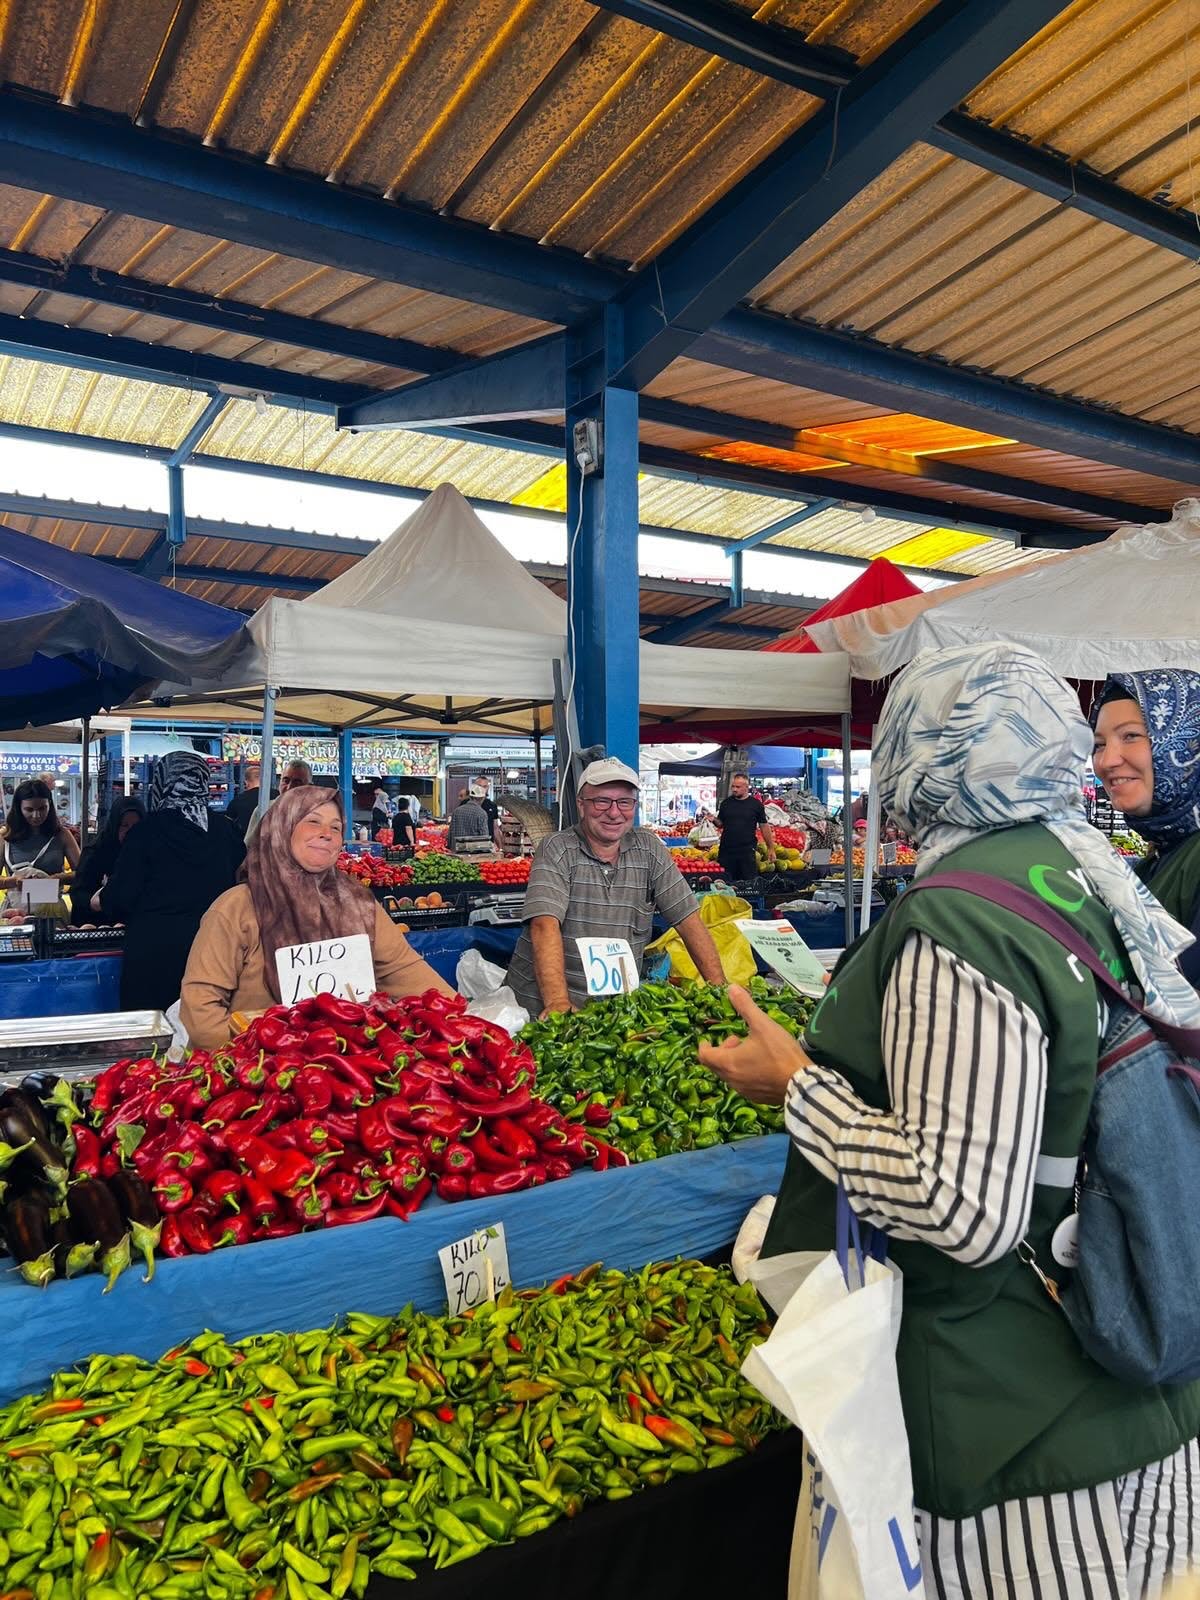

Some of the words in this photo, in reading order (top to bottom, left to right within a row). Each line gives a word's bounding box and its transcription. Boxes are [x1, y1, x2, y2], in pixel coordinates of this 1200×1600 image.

[22, 756, 56, 764] HAYATİ
[241, 741, 304, 757] YÖESEL
[308, 741, 371, 759] ÜRÜER
[376, 747, 423, 760] PAZARI
[588, 945, 622, 992] 50
[453, 1270, 481, 1314] 70
